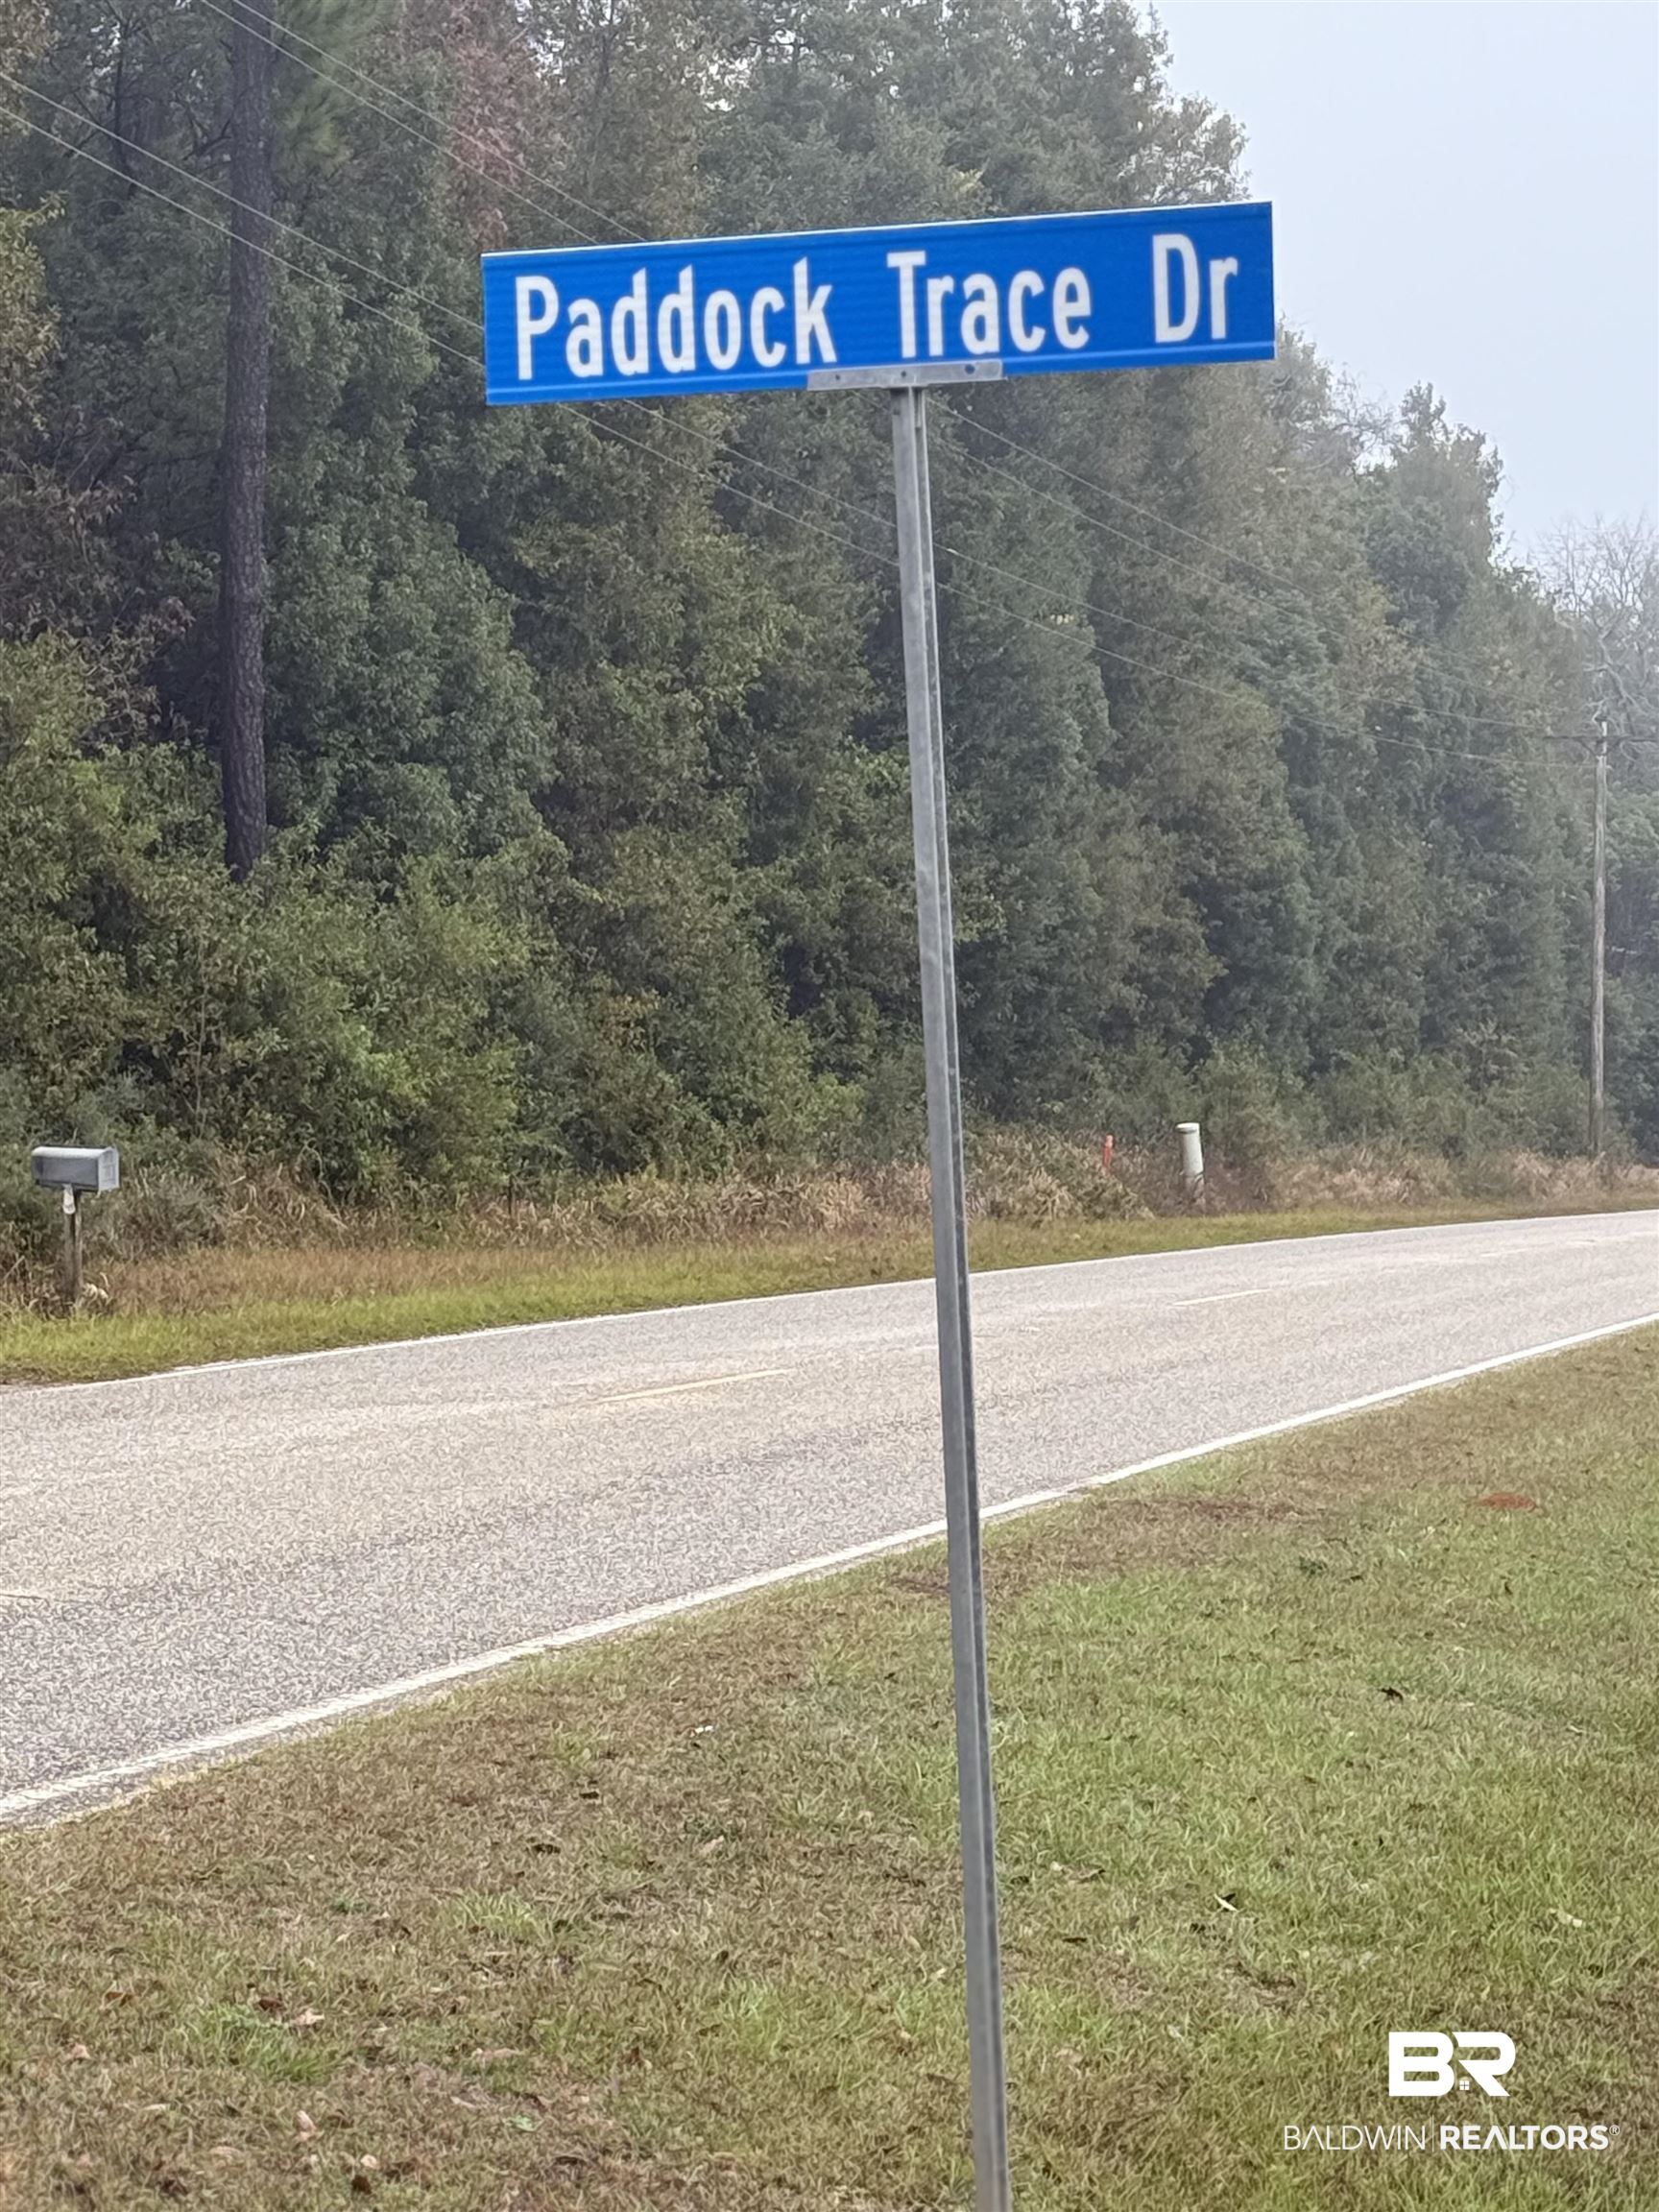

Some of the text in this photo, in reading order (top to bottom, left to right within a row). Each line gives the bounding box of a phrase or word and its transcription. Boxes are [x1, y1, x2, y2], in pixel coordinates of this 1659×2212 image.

[516, 233, 1238, 380] Paddock Trace Dr
